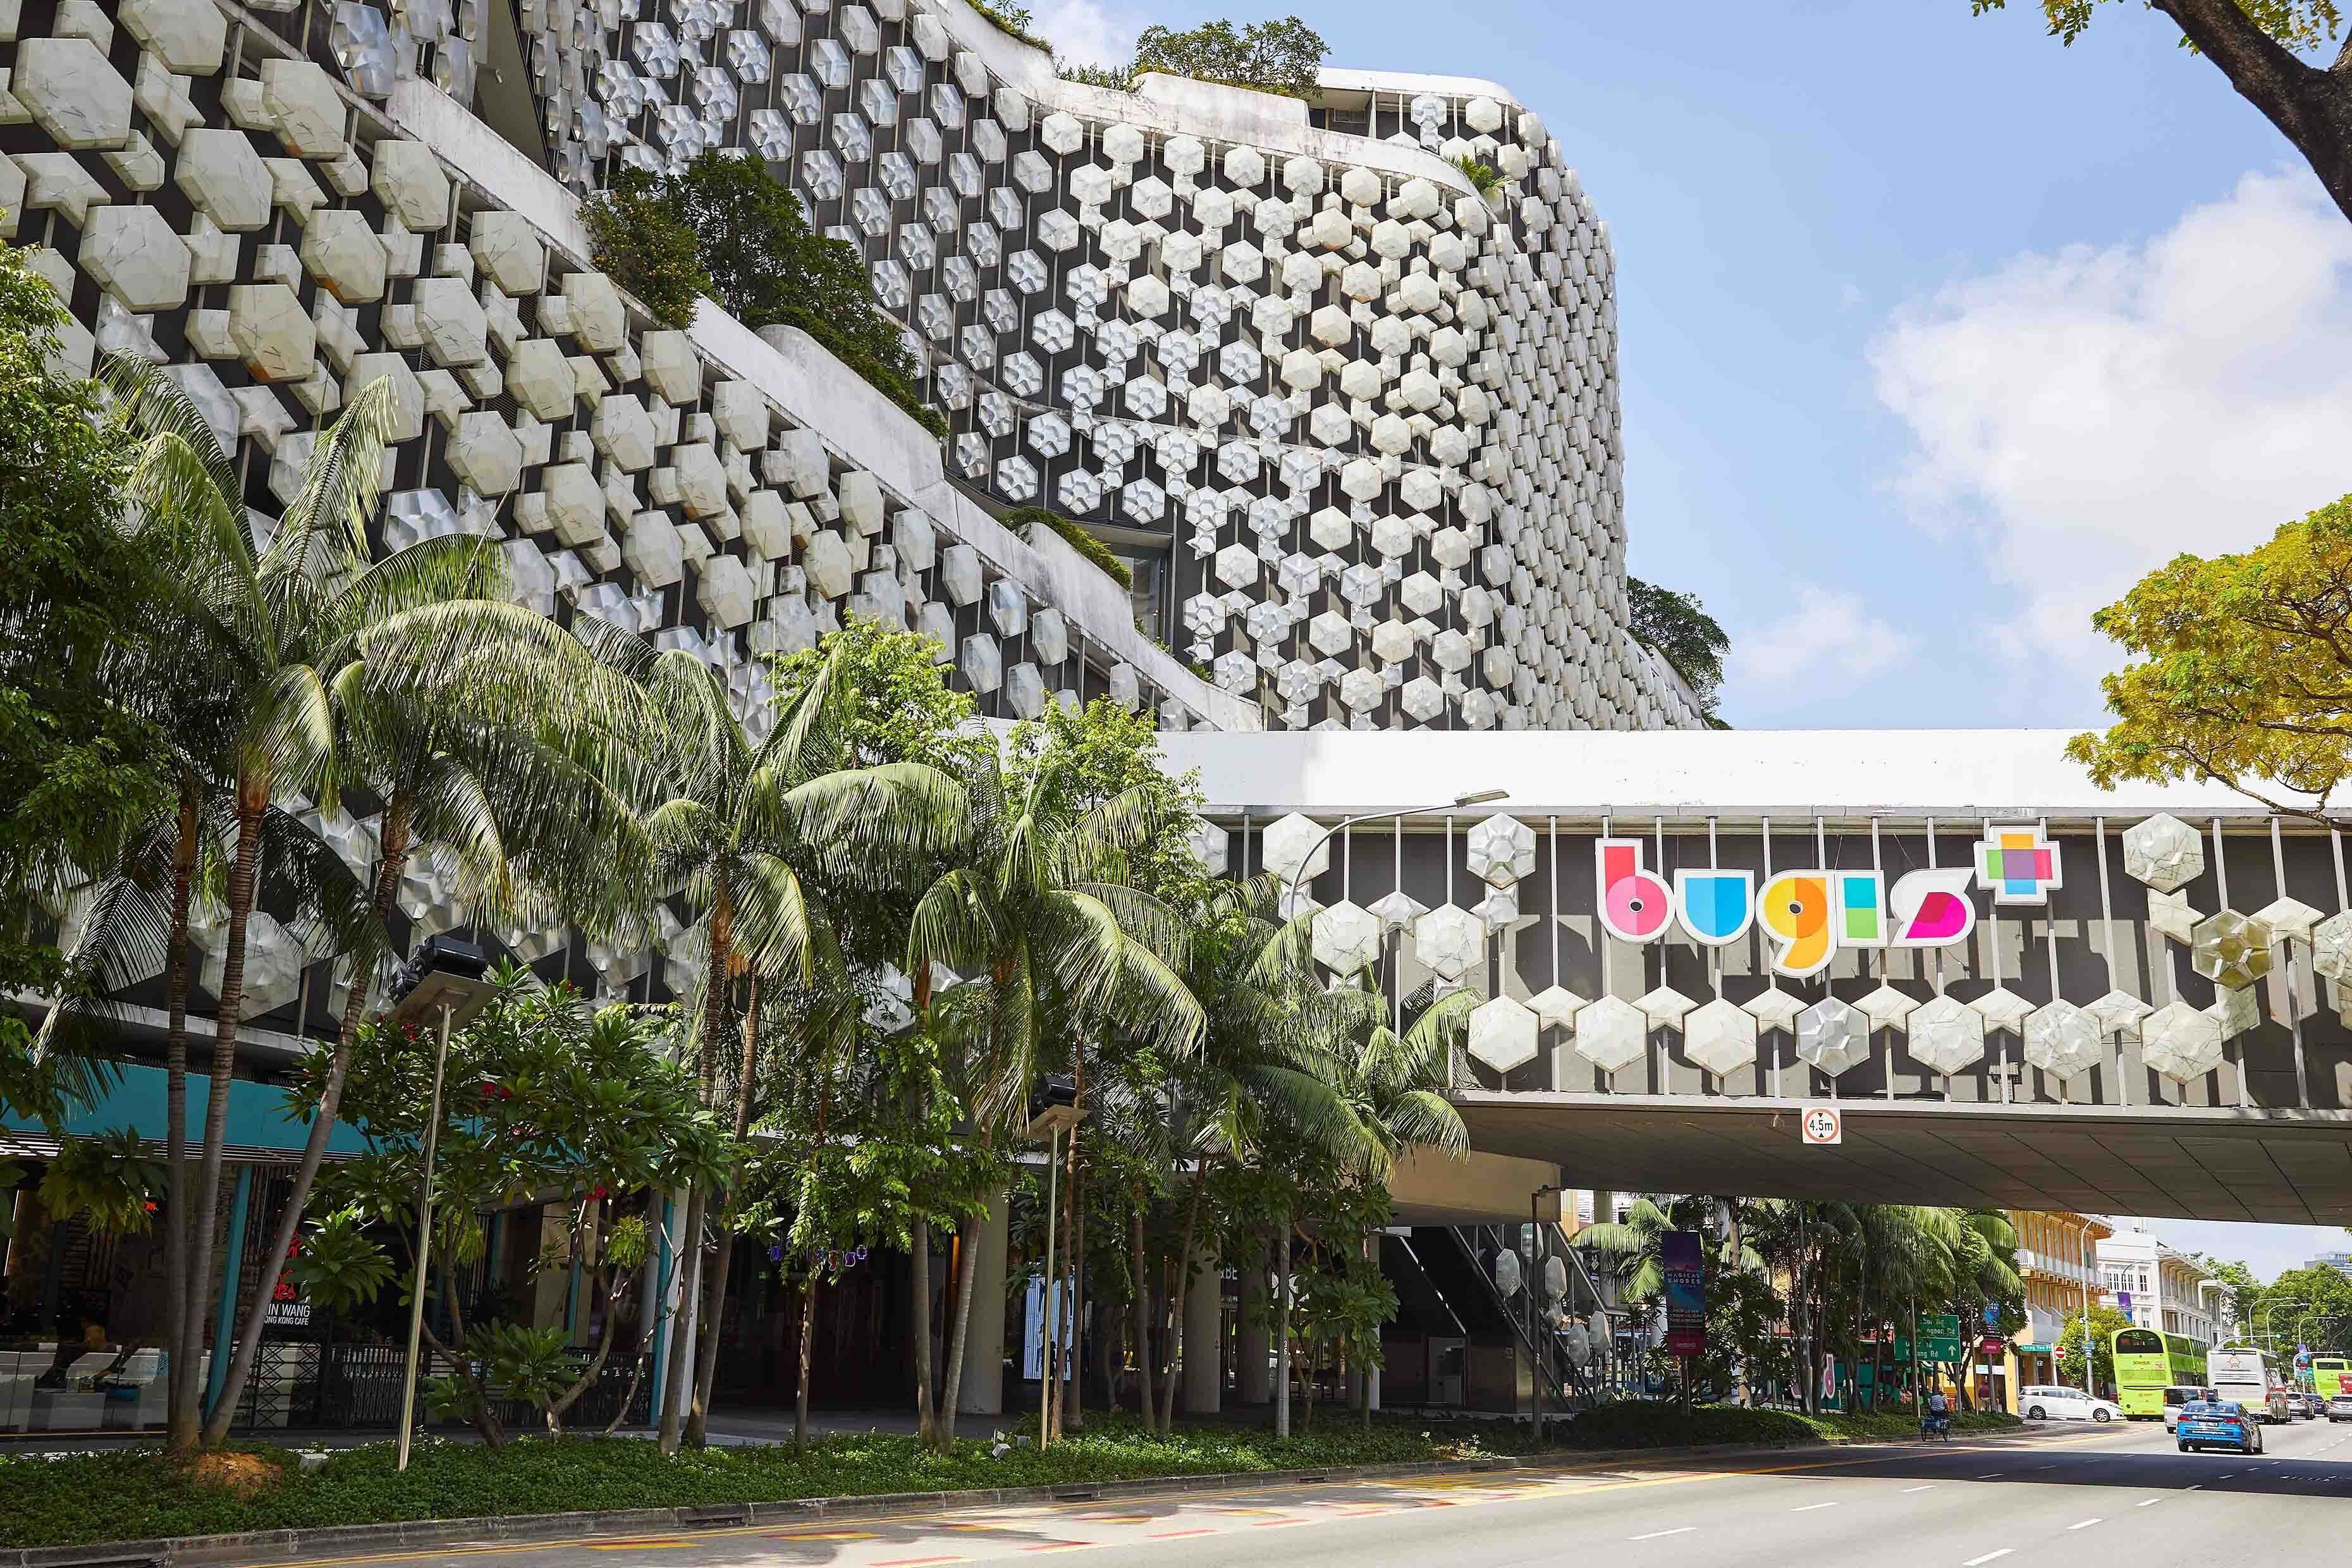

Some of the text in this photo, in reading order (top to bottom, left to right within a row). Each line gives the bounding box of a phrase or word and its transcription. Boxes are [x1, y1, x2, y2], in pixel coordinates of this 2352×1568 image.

[1810, 1120, 1833, 1131] 4.5m
[268, 1304, 310, 1317] IN WANG
[264, 1316, 277, 1324] ONG
